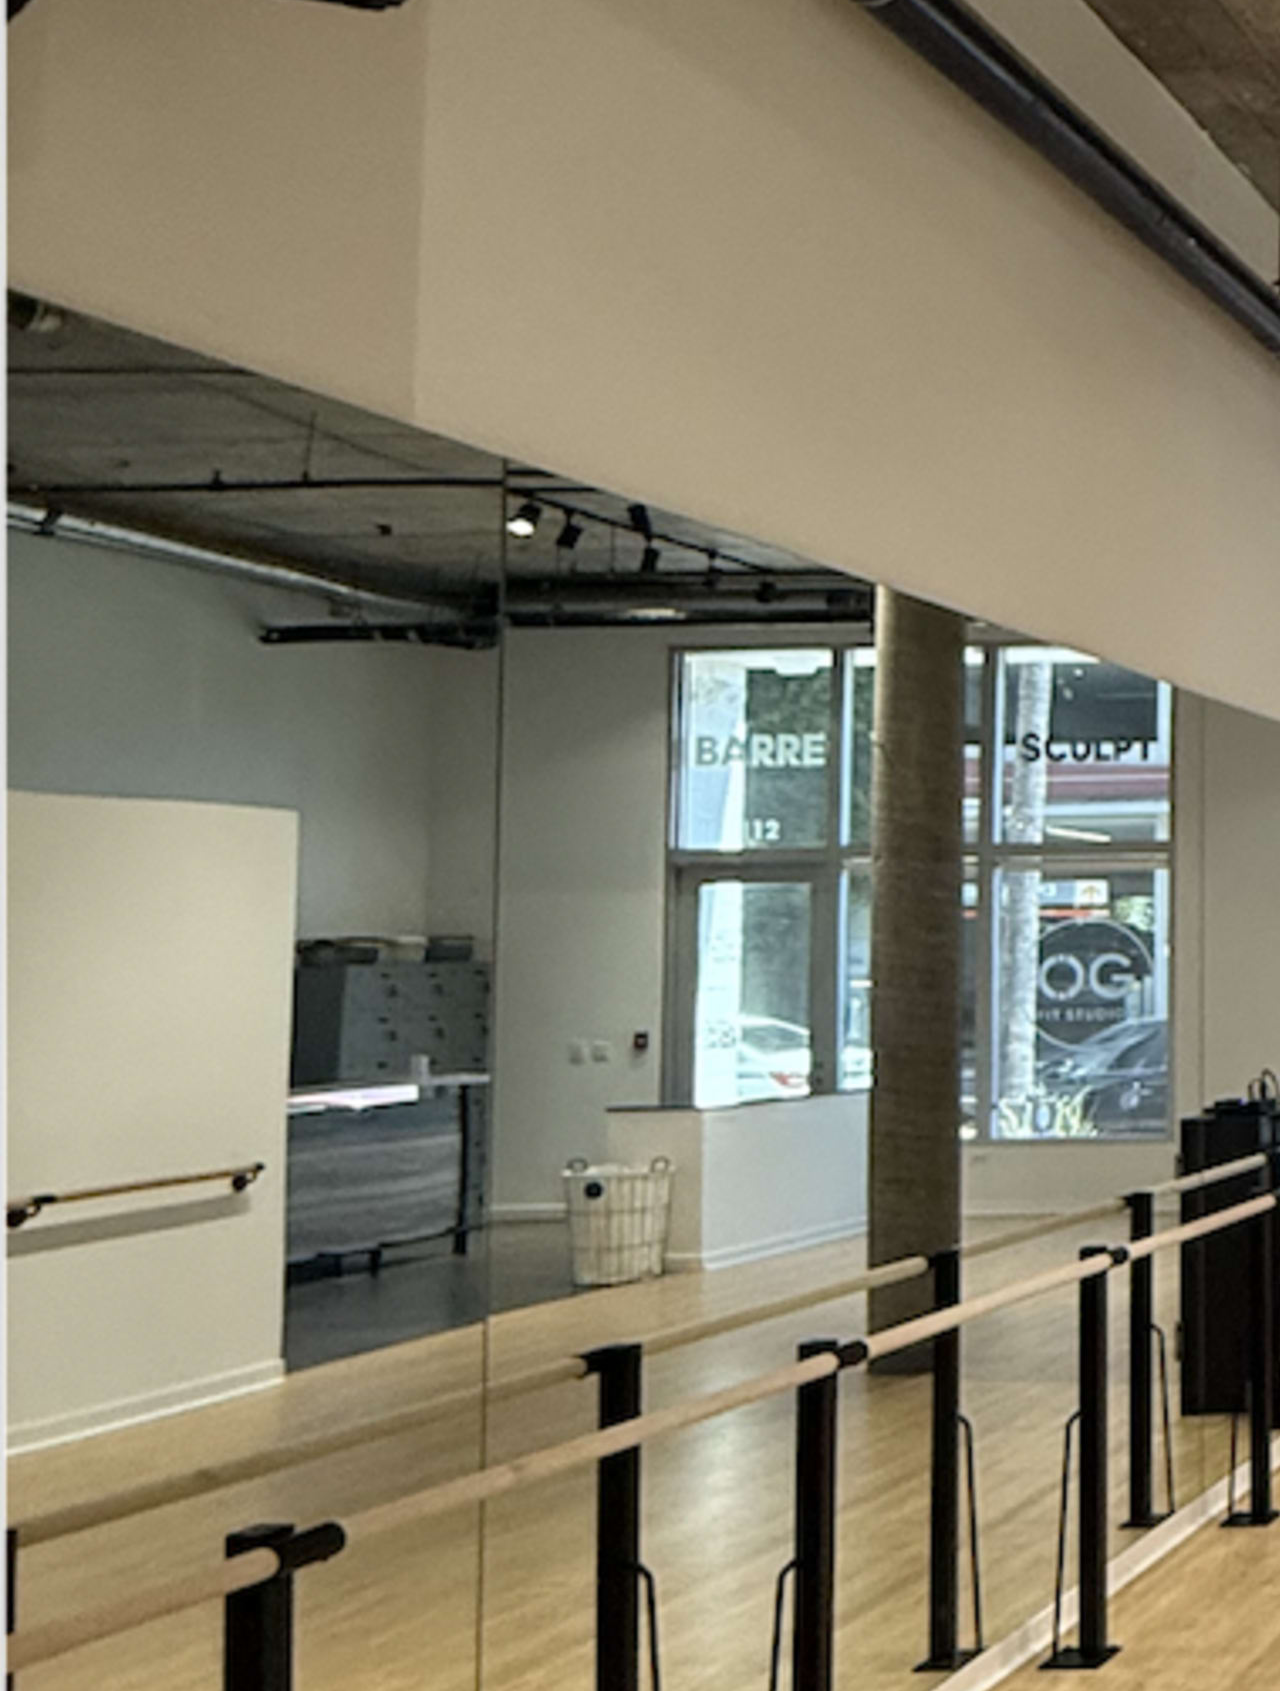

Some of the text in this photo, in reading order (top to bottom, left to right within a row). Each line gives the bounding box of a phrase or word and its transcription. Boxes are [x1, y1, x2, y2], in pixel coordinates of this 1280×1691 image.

[695, 732, 827, 767] BARRE
[1022, 733, 1152, 762] SCULPT
[1038, 953, 1135, 999] OG
